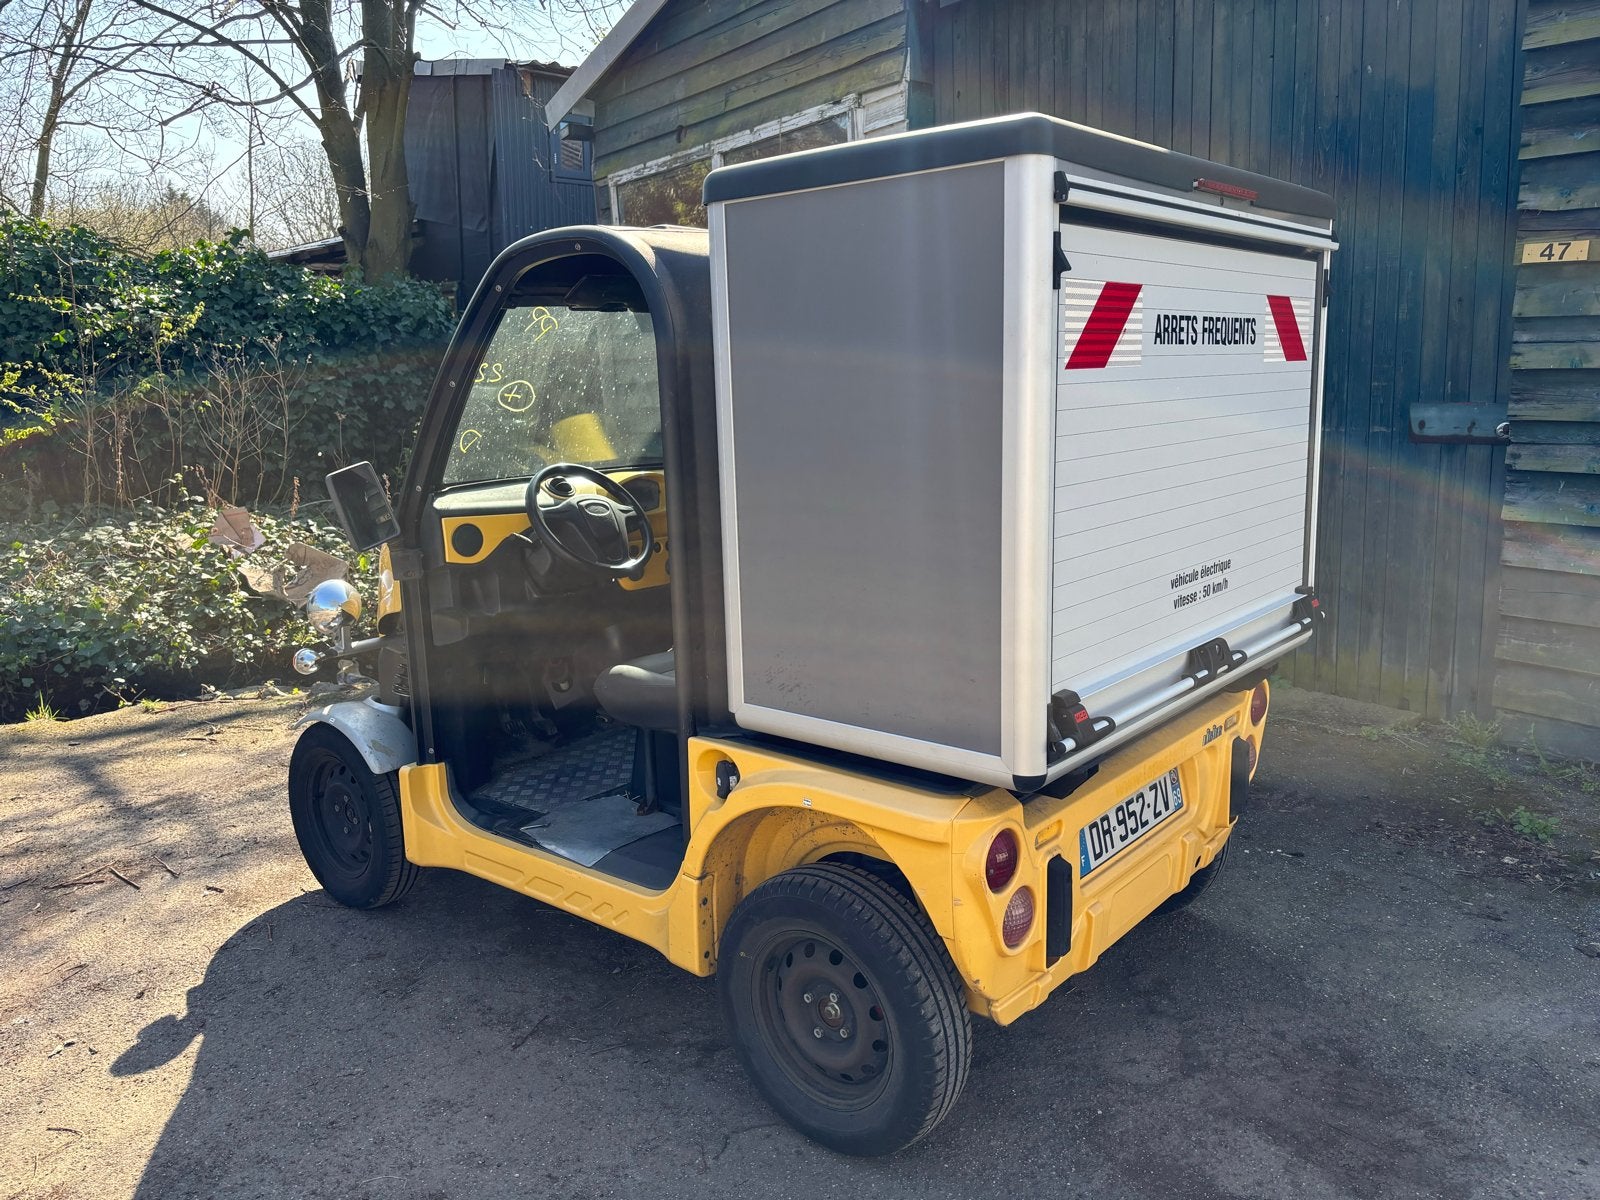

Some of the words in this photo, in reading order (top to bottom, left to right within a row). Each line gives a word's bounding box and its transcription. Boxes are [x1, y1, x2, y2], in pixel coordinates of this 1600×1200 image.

[1540, 242, 1572, 260] 47
[1154, 314, 1198, 345] ARRETS
[1202, 317, 1257, 346] FREQUENTS
[1170, 569, 1199, 589] véhicule
[1200, 559, 1231, 578] électrique
[1173, 591, 1198, 610] vitesse
[1202, 584, 1211, 598] 50
[1212, 578, 1228, 594] km/h
[1088, 775, 1170, 862] DR-952-ZV
